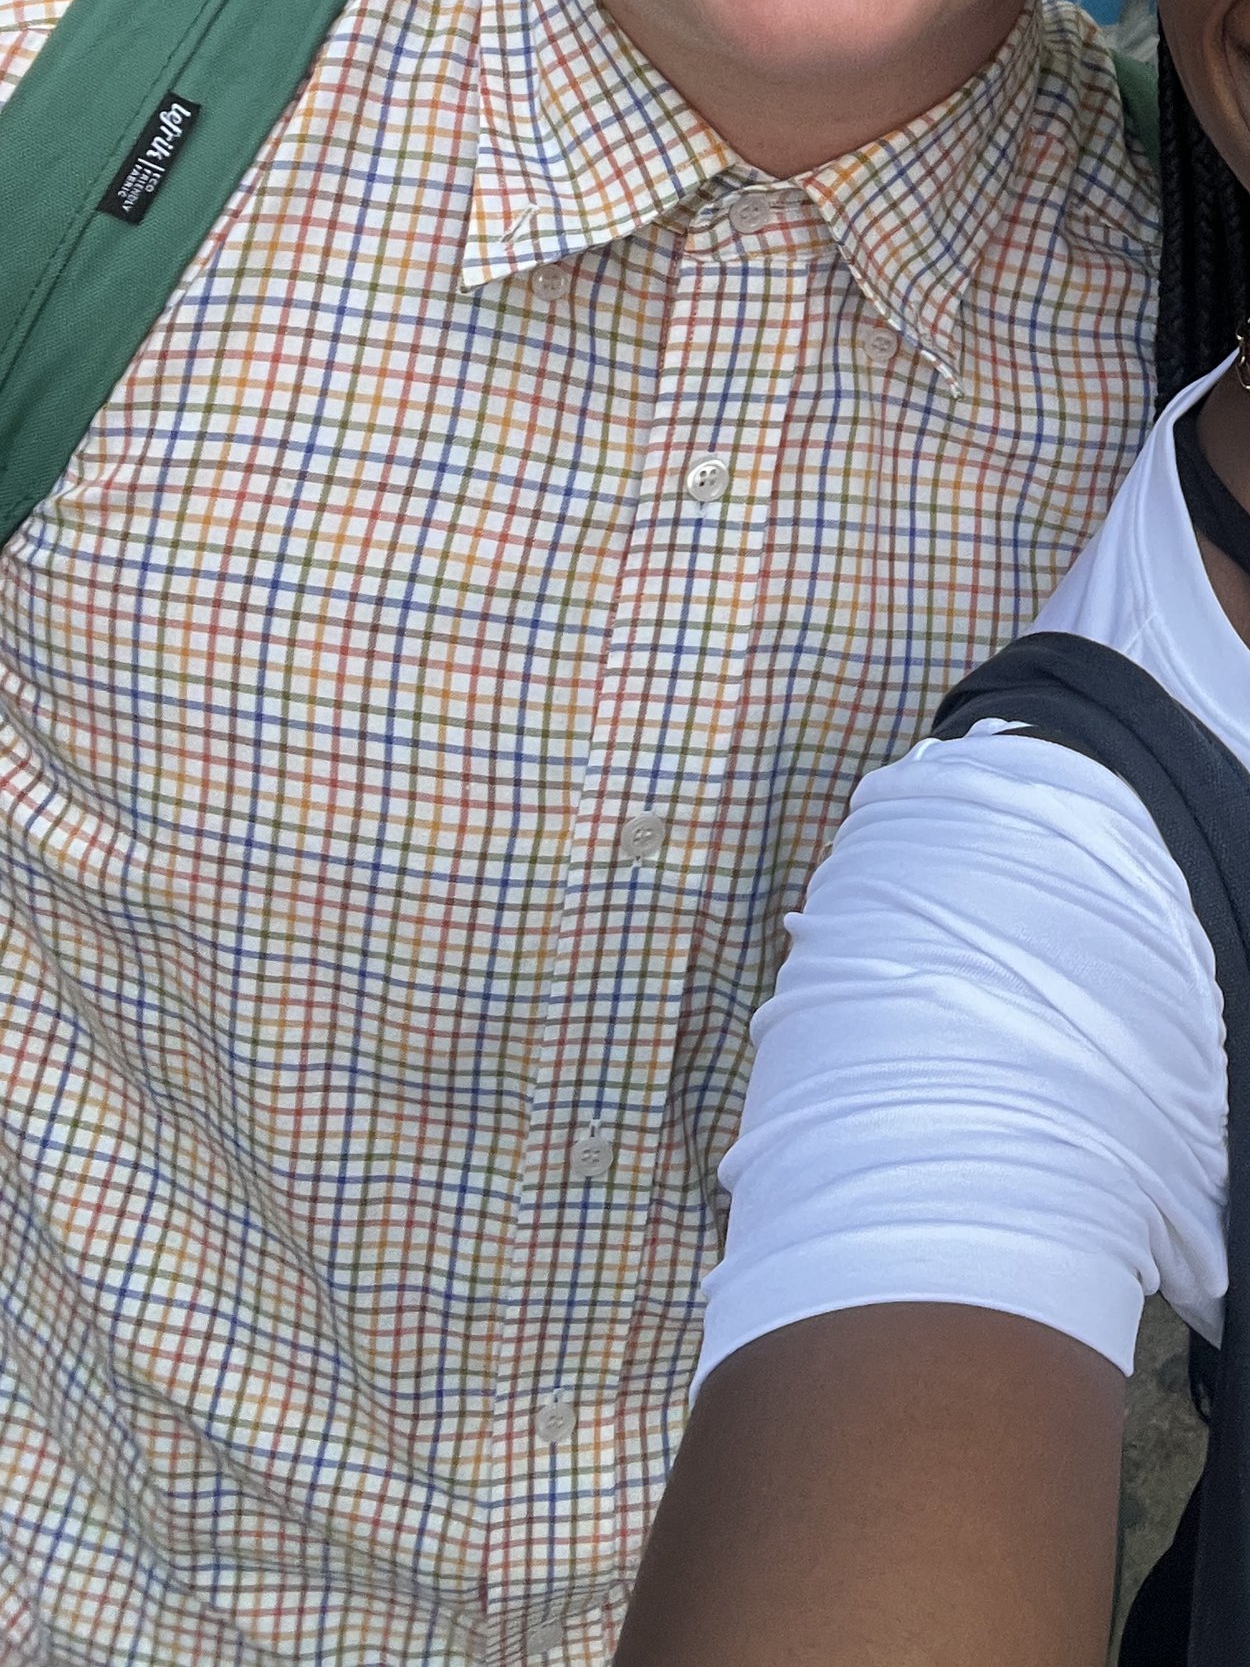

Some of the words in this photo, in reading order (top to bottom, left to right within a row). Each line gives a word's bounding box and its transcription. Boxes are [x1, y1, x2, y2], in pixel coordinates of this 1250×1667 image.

[117, 163, 143, 199] FABRIC
[122, 167, 152, 213] FRIENDLY
[144, 172, 163, 194] ECO
